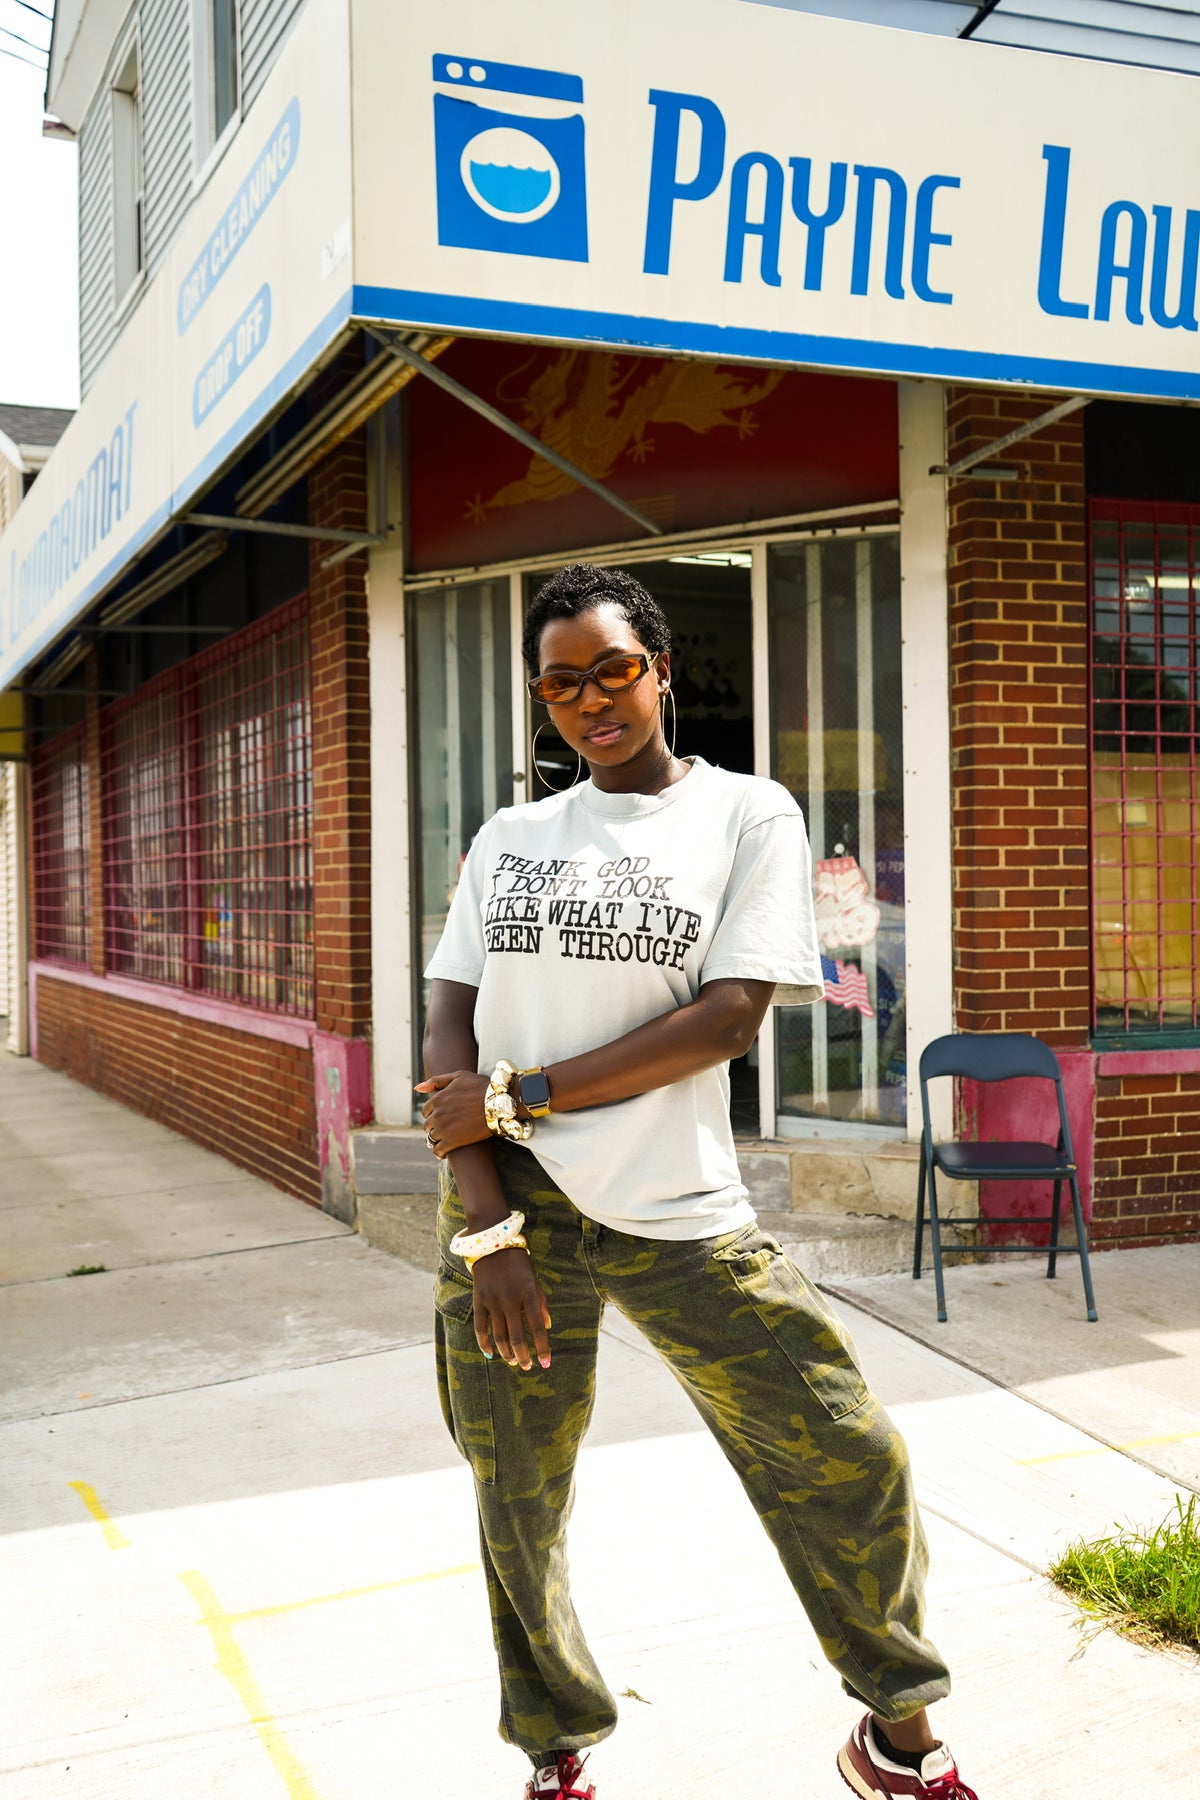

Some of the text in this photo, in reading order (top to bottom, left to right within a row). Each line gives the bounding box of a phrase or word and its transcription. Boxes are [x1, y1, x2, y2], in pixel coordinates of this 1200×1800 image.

[183, 122, 291, 321] DRY CLEANING
[643, 88, 1200, 332] PAYNE LAU
[198, 299, 263, 416] DROP OFF
[9, 400, 138, 645] LAUNDROMAT
[490, 874, 501, 899] I
[596, 875, 674, 901] LOOK
[496, 853, 650, 878] THANK GOD
[889, 860, 905, 873] PEP
[485, 896, 702, 943] LIKE WHAT I'VE
[559, 929, 690, 972] THROUGH
[885, 1070, 906, 1088] PEPS
